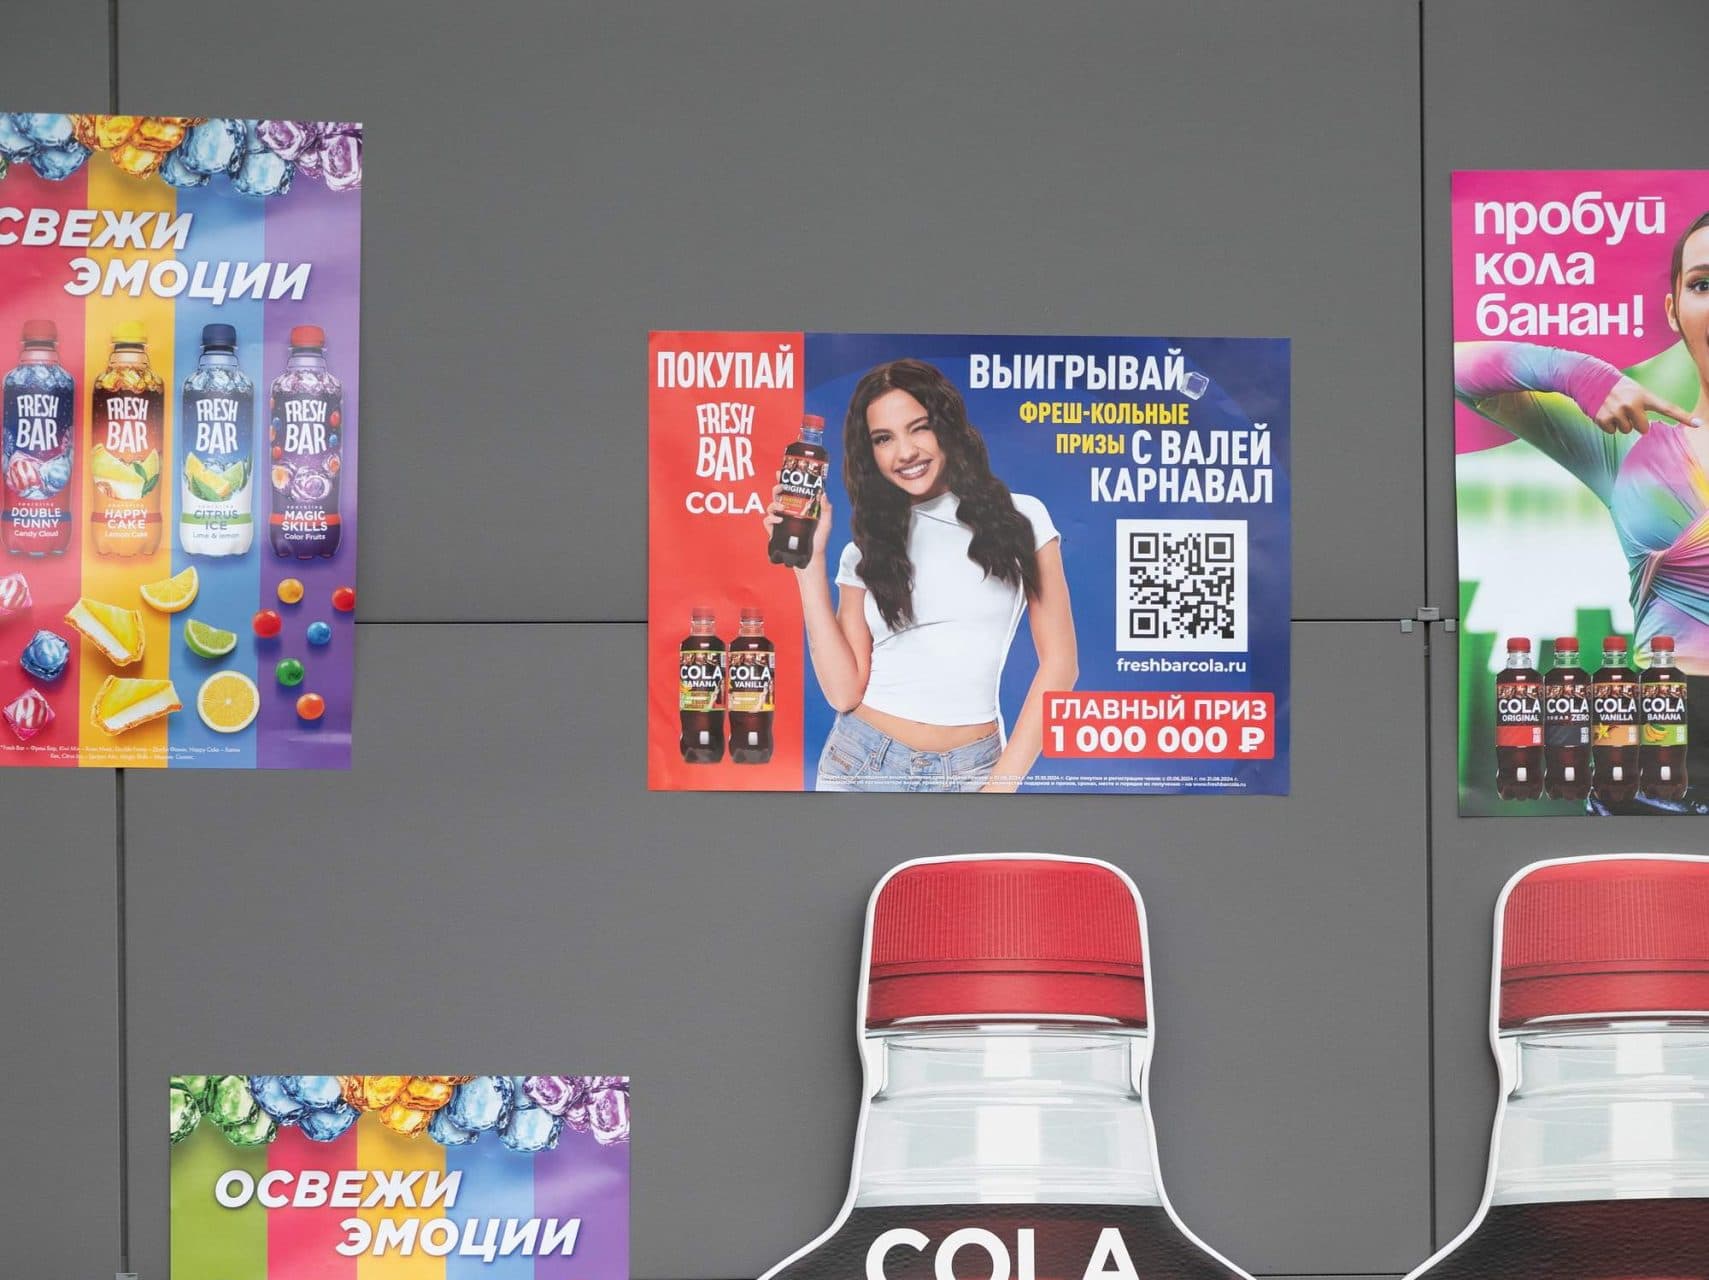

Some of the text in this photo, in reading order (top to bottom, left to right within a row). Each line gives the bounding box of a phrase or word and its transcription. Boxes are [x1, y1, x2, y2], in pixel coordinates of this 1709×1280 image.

[1474, 191, 1666, 245] пробуй
[1475, 252, 1595, 286] кола
[64, 257, 312, 305] ЭМОЦИИ
[1476, 293, 1644, 338] банан!
[657, 343, 794, 389] ПОКУПАЙ
[969, 348, 1185, 391] ВЫИГРЫВАЙ
[17, 395, 59, 418] FRESH
[106, 397, 149, 420] FRESH
[196, 398, 238, 422] FRESH
[285, 399, 327, 423] FRESH
[1019, 401, 1190, 425] ФРЕШ-КОЛЬНЫЕ
[696, 402, 755, 435] FRESH
[16, 418, 59, 451] BAR
[106, 421, 148, 453] BAR
[195, 422, 238, 454] BAR
[284, 422, 327, 455] BAR
[1056, 422, 1271, 466] ПРИЗЫ С ВАЛЕЙ
[696, 436, 755, 482] BAR
[781, 469, 822, 488] COLA
[1090, 467, 1273, 503] КАРНАВАЛ
[11, 507, 62, 518] DOUBLE
[104, 509, 148, 519] HAPPY
[194, 510, 239, 519] CITRUS
[685, 491, 765, 515] COLA
[13, 518, 60, 529] FUNNY
[107, 519, 145, 529] CAKE
[205, 521, 228, 530] ICE
[281, 521, 328, 532] SKILLS
[284, 510, 326, 521] MAGIC
[680, 665, 723, 680] COLA
[729, 666, 771, 680] COLA
[1116, 658, 1247, 673] freshbarcola.ru
[1050, 694, 1267, 720] ГЛАВНЫЙ ПРИЗ
[1498, 698, 1541, 714] COLA
[1546, 698, 1589, 714] COLA
[1594, 698, 1637, 713] COLA
[1642, 697, 1685, 713] COLA
[1502, 713, 1539, 722] ORIGINAL
[1571, 713, 1590, 721] ZERO
[1600, 713, 1634, 721] VANILLA
[1647, 713, 1681, 721] BANANA
[1050, 725, 1065, 752] 1
[1076, 725, 1147, 753] 000
[1157, 726, 1228, 753] 000
[214, 1169, 463, 1209] ОСВЕЖИ
[335, 1217, 581, 1263] ЭМОЦИИ
